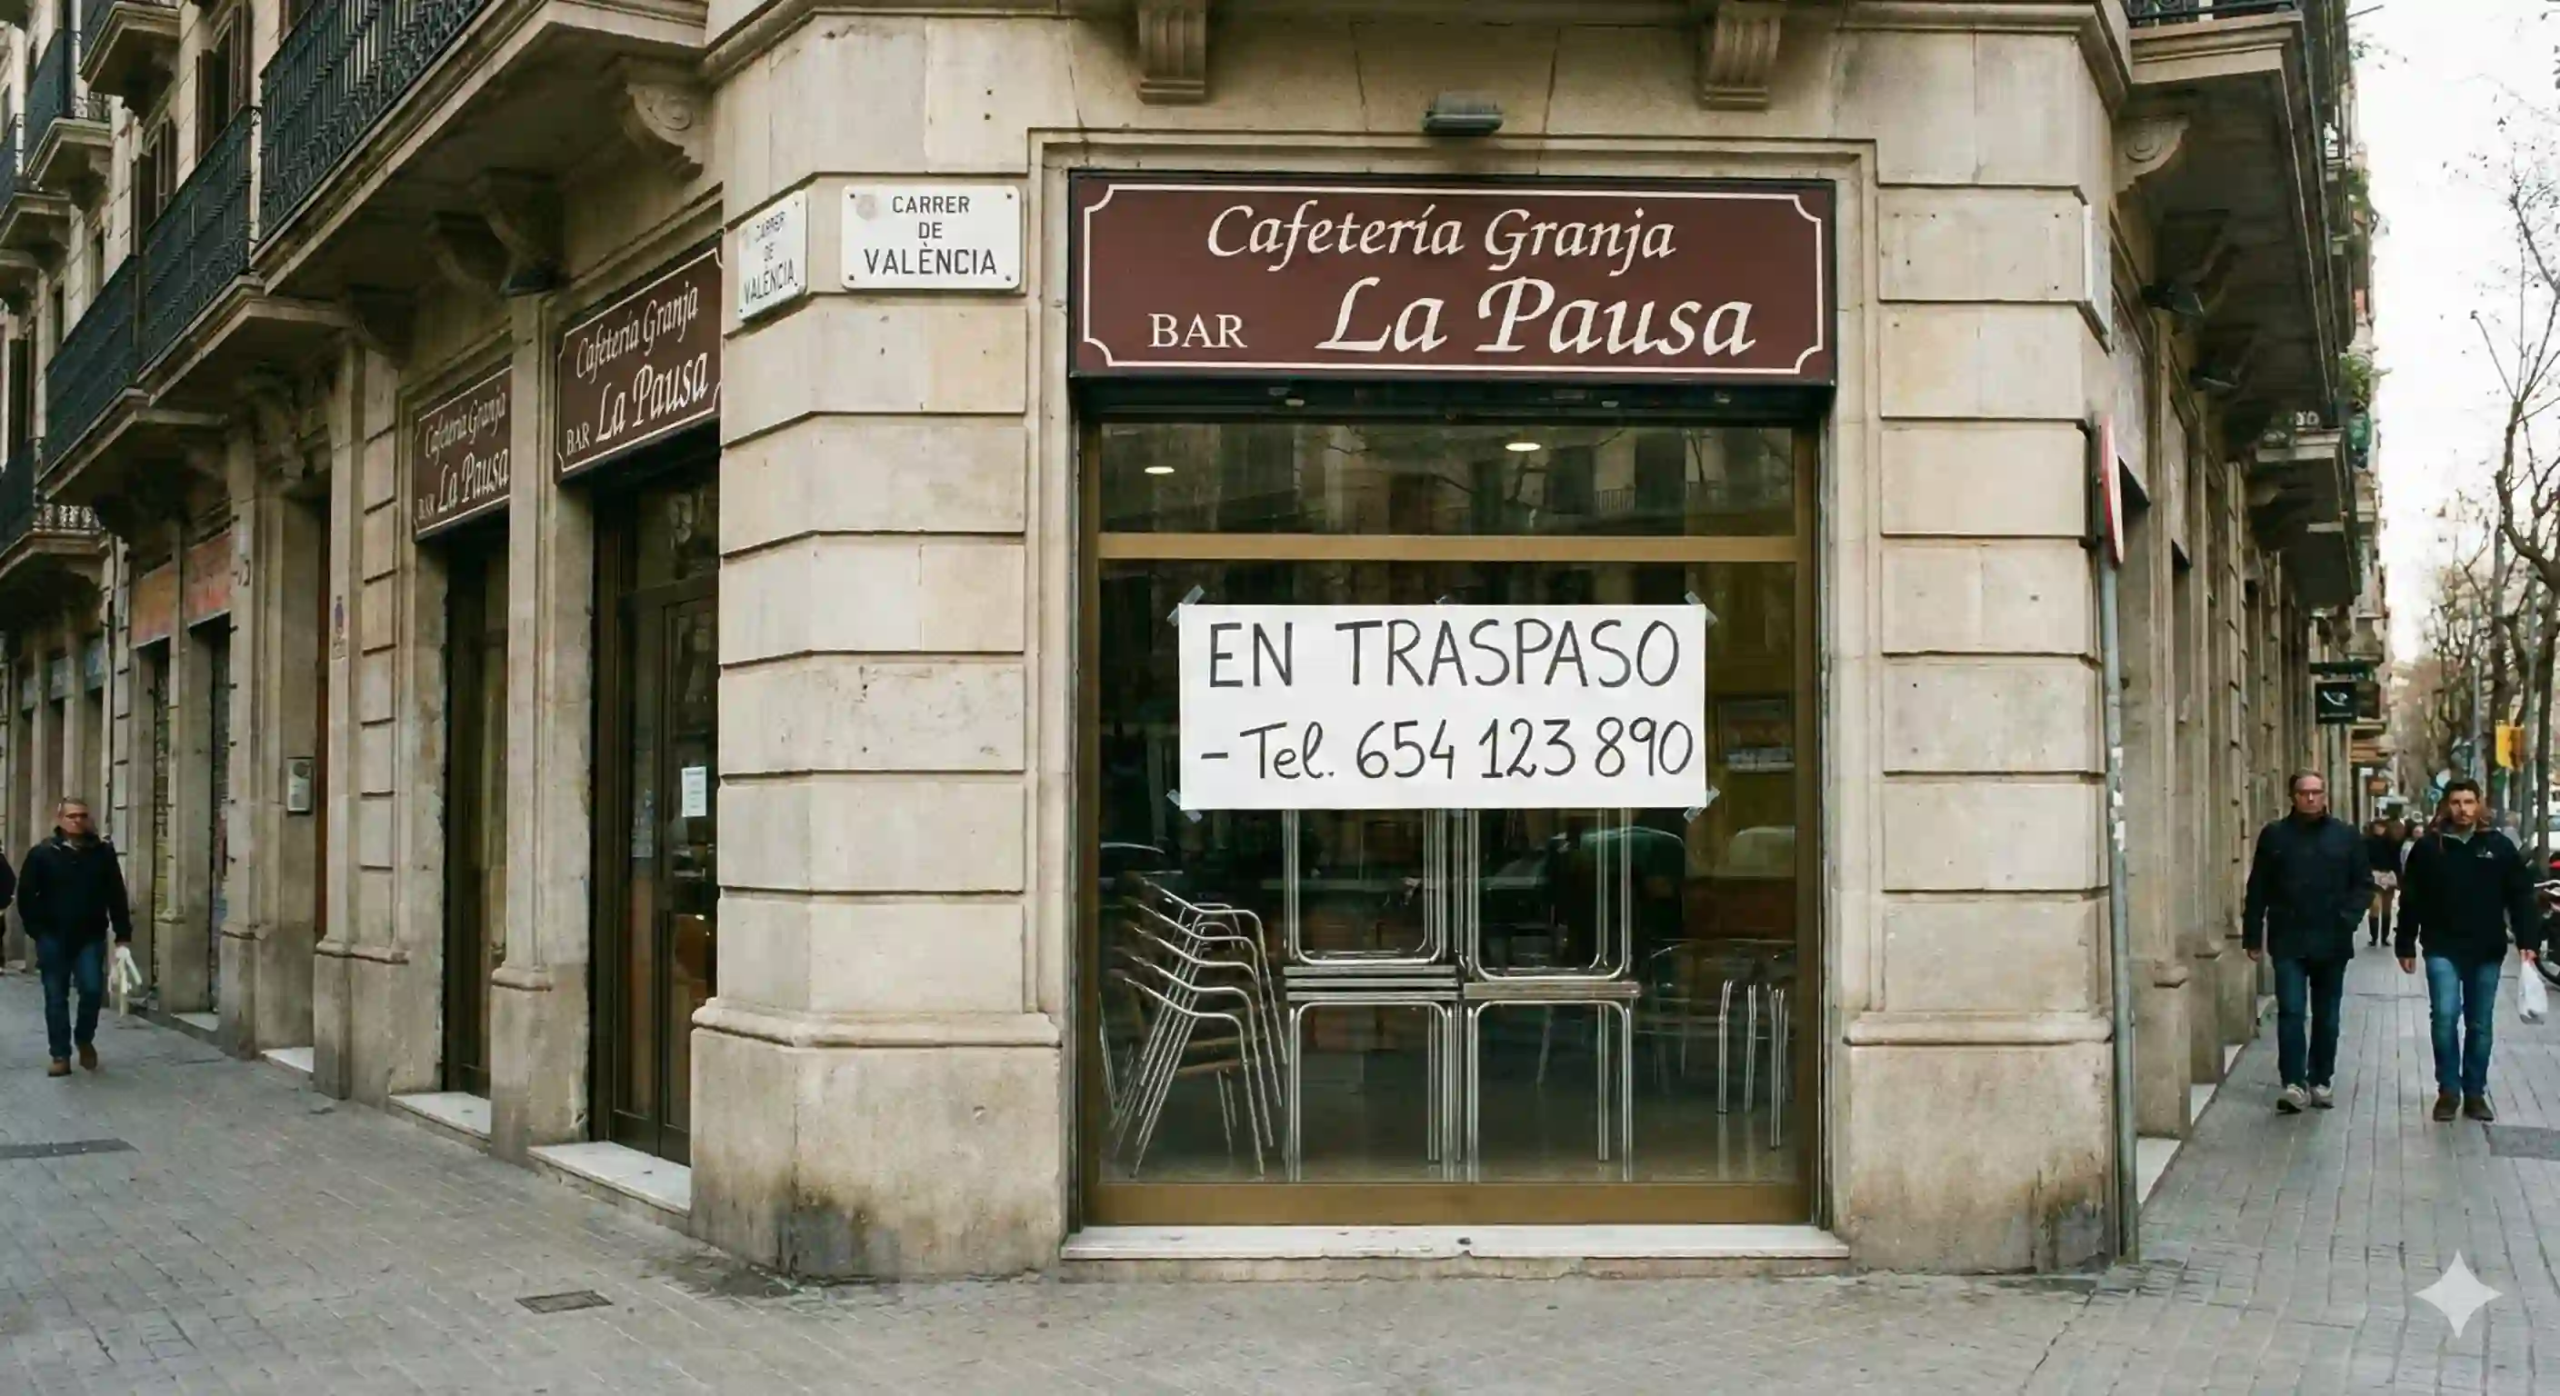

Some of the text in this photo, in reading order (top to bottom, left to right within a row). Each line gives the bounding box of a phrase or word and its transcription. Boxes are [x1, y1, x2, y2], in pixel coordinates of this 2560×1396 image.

[755, 211, 786, 242] CARRER
[892, 195, 971, 214] CARRER
[918, 221, 943, 239] DE
[864, 242, 998, 275] VALÈNCIA
[1207, 199, 1677, 277] Cafetería Granja
[743, 258, 796, 304] VALÈNCIA
[576, 281, 698, 385] Cafetería Granja
[1148, 276, 1757, 356] BAR La Pausa
[566, 352, 709, 456] BAR La Pausa
[438, 464, 458, 513] La
[461, 448, 510, 503] Pausa
[1208, 618, 1680, 688] EN TRASPASO
[1356, 719, 1455, 780] 654
[1478, 718, 1577, 779] 123
[1594, 716, 1694, 778] 890
